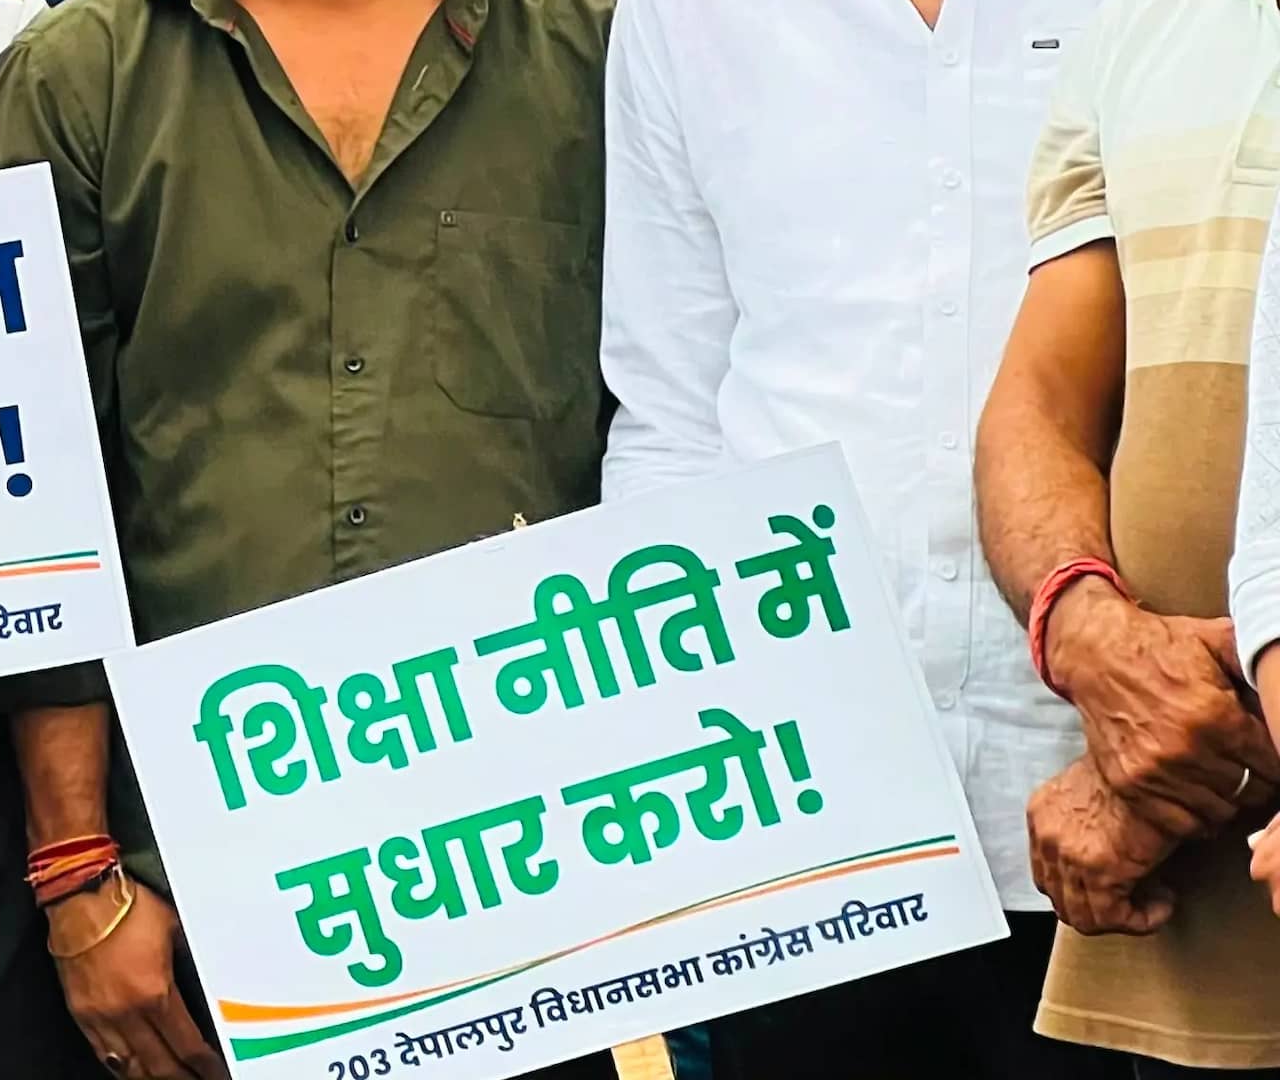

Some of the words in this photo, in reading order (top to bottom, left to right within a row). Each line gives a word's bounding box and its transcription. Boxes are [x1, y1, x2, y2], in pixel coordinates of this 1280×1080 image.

[191, 663, 475, 812] शिक्षा
[473, 543, 737, 716] नीति
[734, 503, 852, 640] में
[274, 794, 560, 988] सुधार
[559, 707, 824, 866] करो!
[328, 1048, 392, 1080] 203
[393, 1006, 528, 1067] देपालपुर
[528, 955, 706, 1029] विधानसभा
[705, 924, 814, 976] कांग्रेस
[814, 892, 929, 945] परिवार
